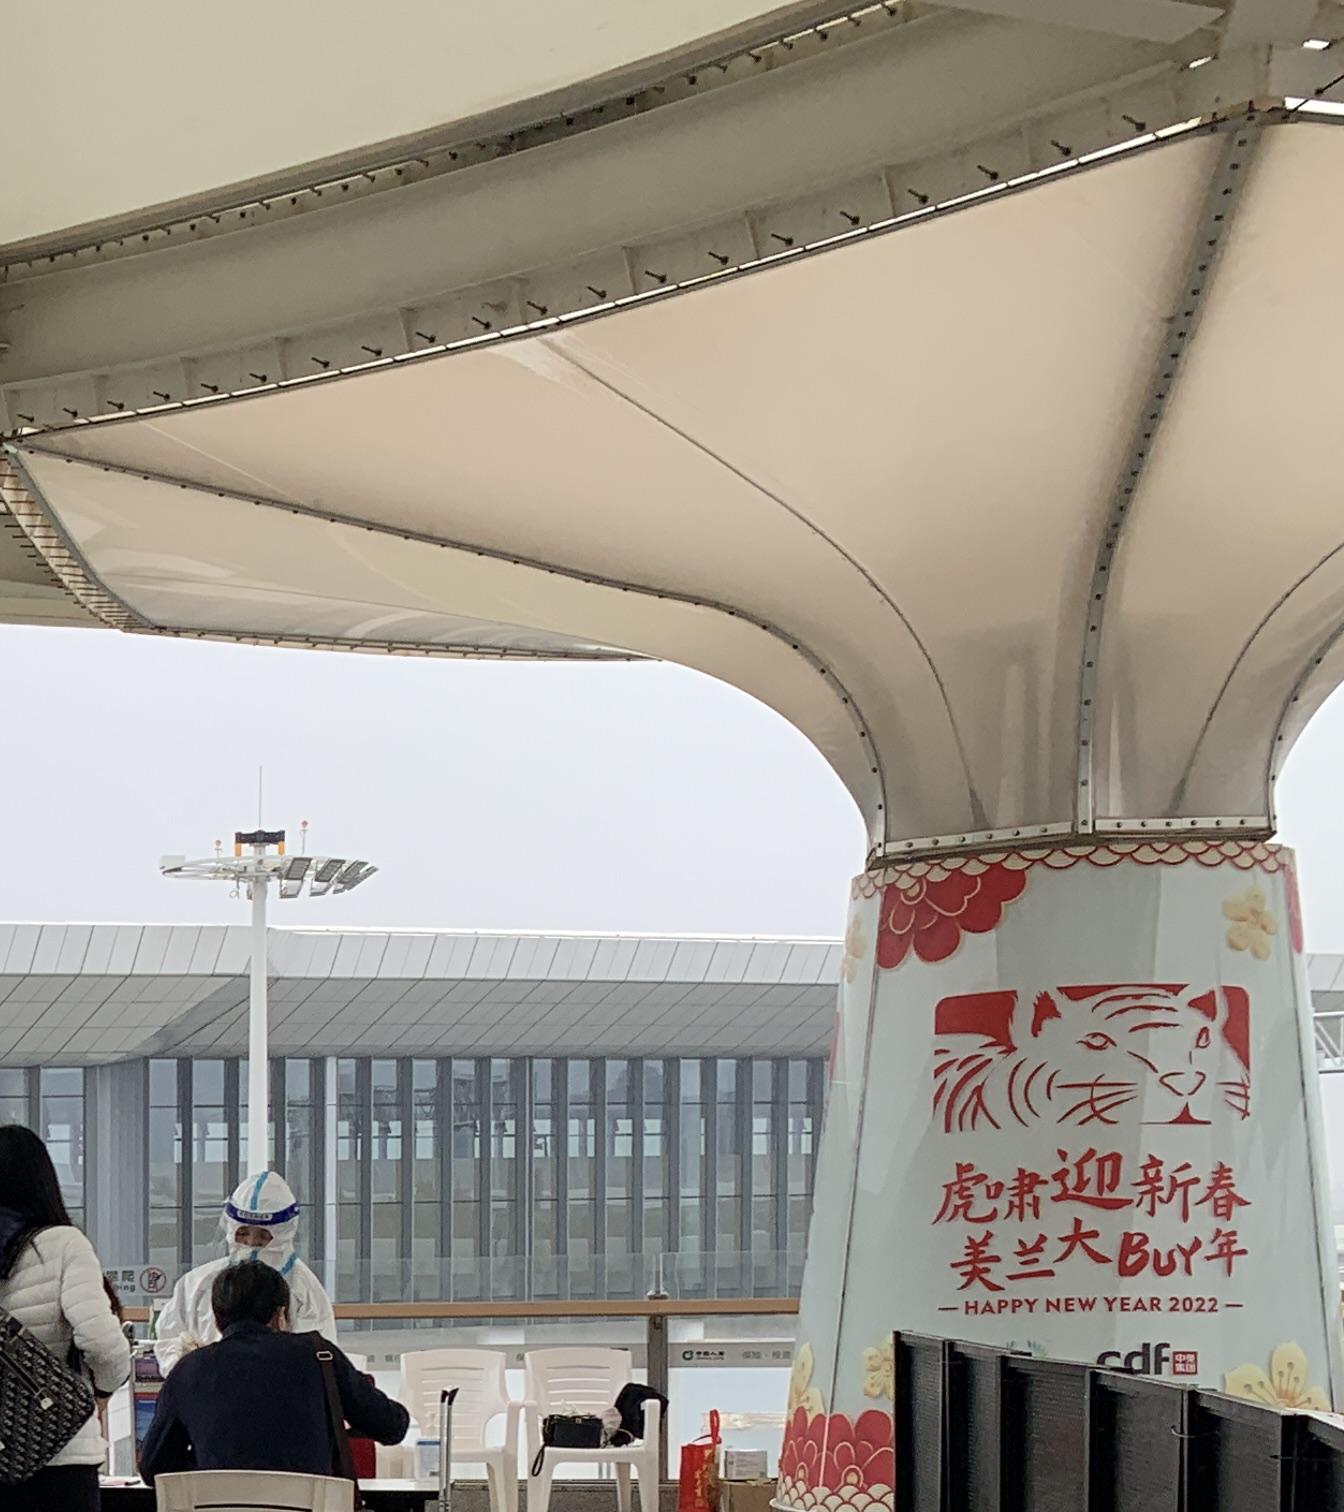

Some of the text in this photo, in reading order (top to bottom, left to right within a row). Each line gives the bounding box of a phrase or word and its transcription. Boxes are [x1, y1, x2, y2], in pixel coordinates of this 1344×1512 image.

[931, 1147, 1252, 1225] 虎啸迎新春
[964, 1296, 1219, 1315] HAPPY NEW YEAR 2022
